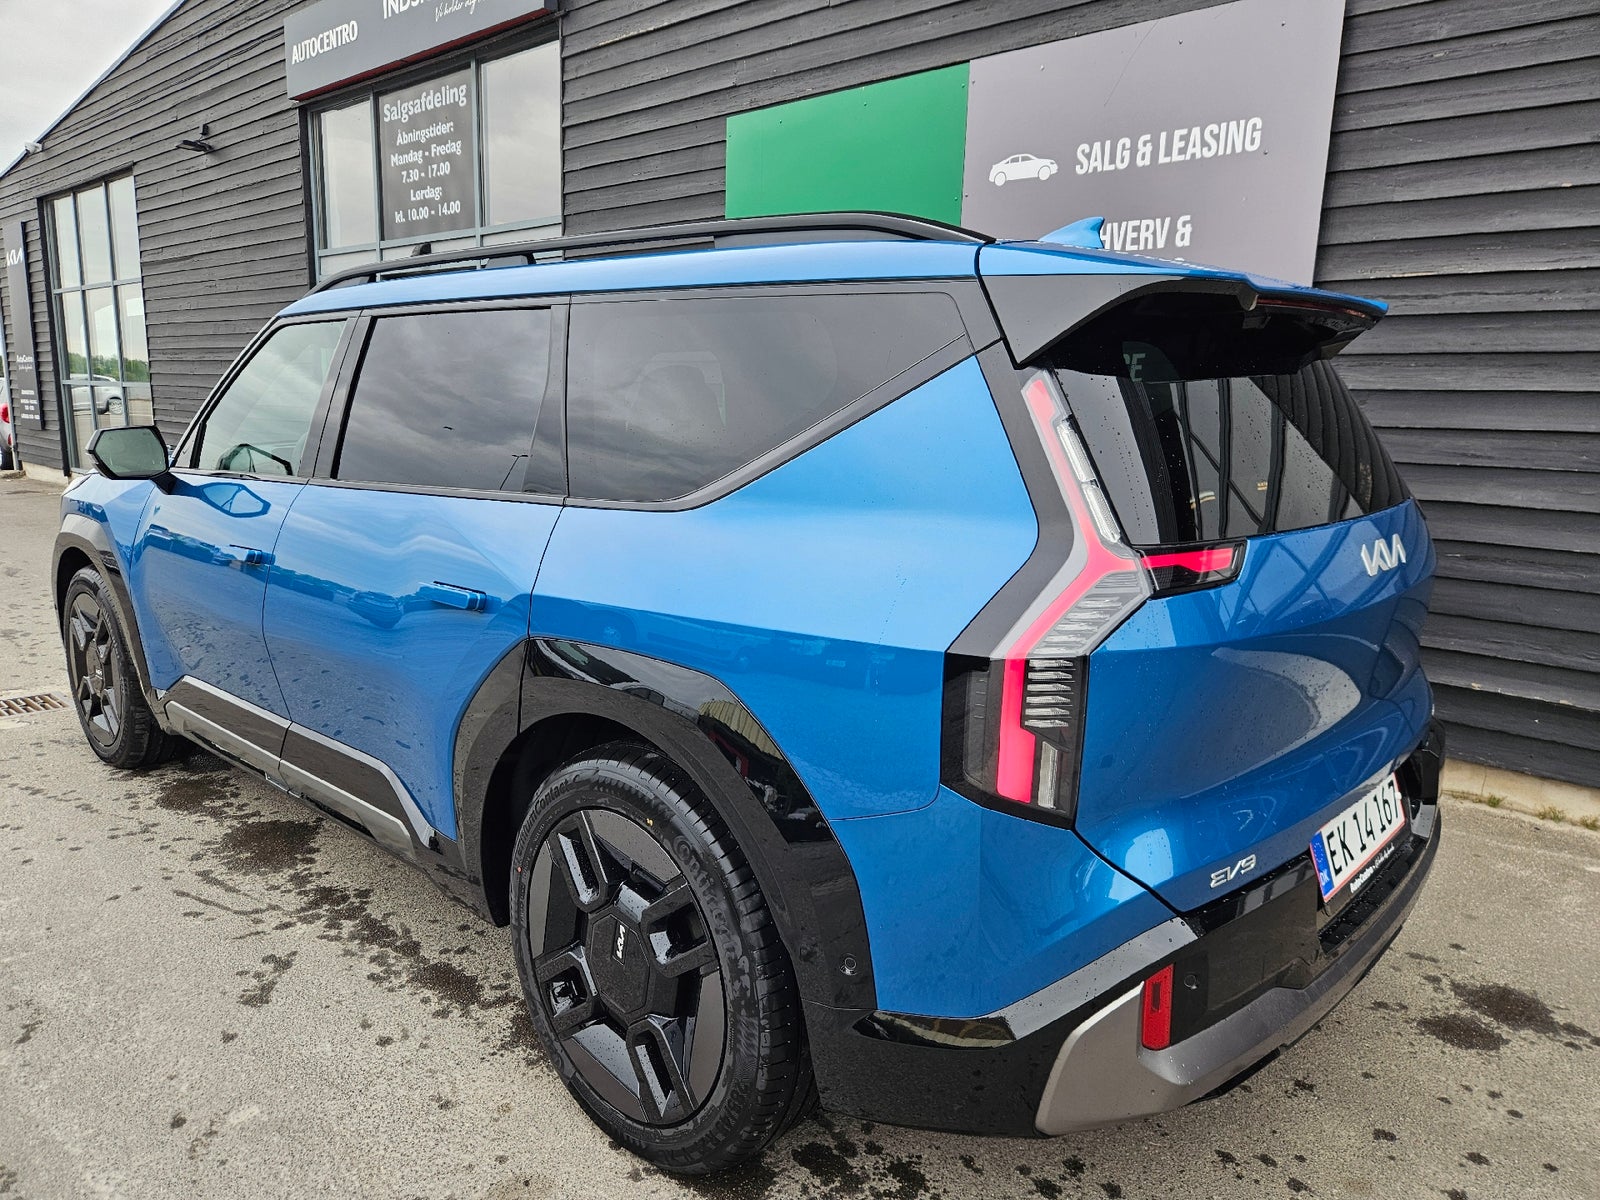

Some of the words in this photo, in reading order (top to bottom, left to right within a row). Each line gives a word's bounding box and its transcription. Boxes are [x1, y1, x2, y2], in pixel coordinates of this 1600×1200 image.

[292, 20, 358, 65] AUTOCENTRO
[383, 84, 467, 123] Salgsafdeling
[396, 121, 454, 146] Åbningstider:
[1075, 137, 1131, 175] SALG
[1136, 134, 1153, 167] &
[1158, 117, 1263, 164] LEASING
[390, 150, 423, 167] Mandag
[431, 140, 462, 157] Fredag
[401, 168, 419, 183] 7.30
[428, 161, 451, 178] 17.00
[410, 186, 442, 201] Lørdag:
[394, 211, 405, 223] kl.
[408, 206, 429, 220] 10.00
[439, 200, 461, 216] 14.00
[1100, 217, 1171, 251] HVERV
[1175, 214, 1192, 247] &
[1360, 533, 1407, 577] KIA
[1326, 820, 1355, 876] EK
[1353, 802, 1376, 853] 14
[1373, 780, 1398, 833] 167
[1210, 854, 1257, 888] EV9
